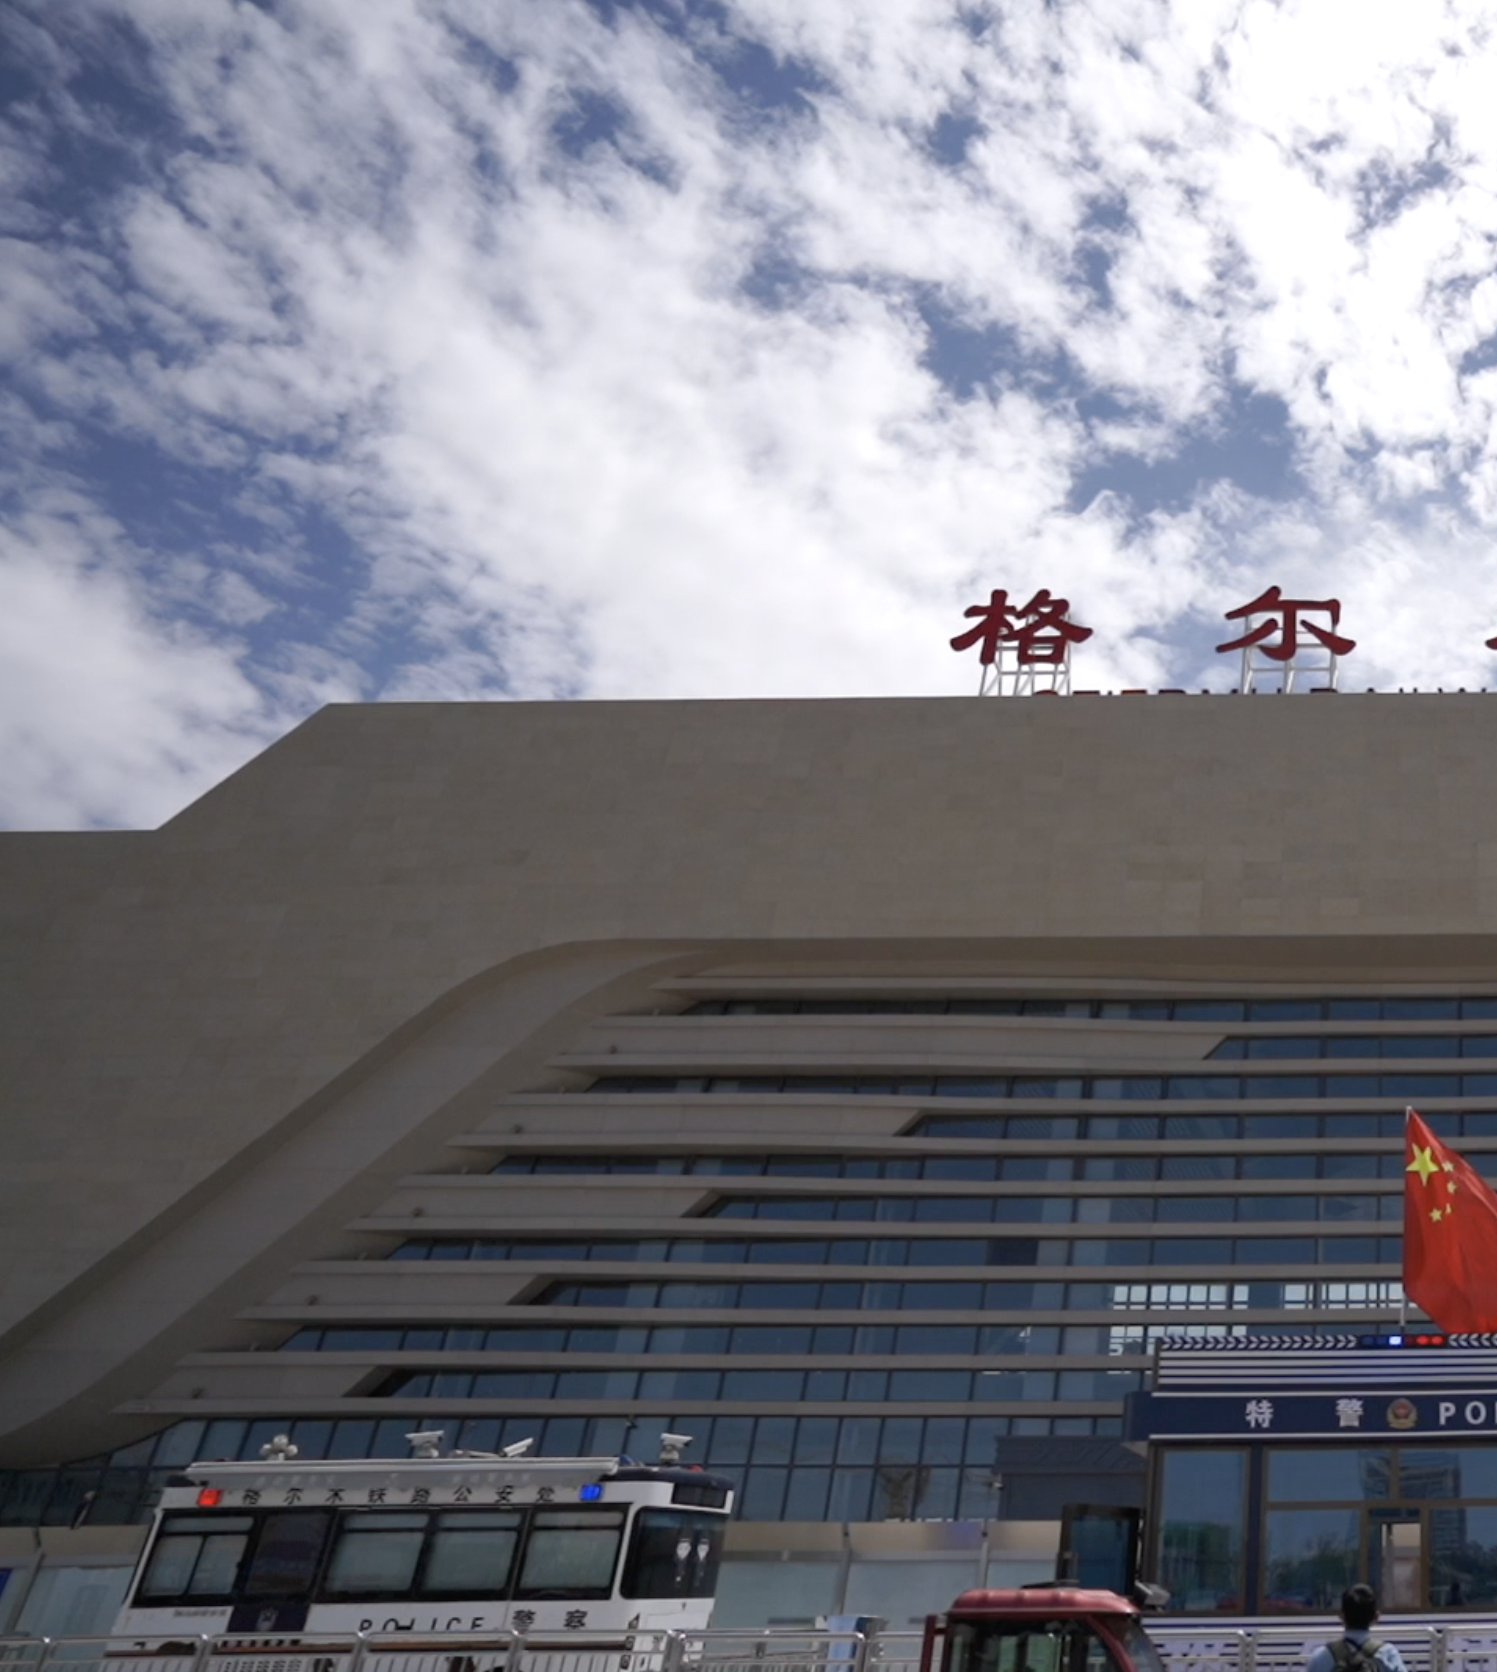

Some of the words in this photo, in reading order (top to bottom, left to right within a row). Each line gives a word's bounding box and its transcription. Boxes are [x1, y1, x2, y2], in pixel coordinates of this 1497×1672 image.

[1245, 1398, 1364, 1429] 特警
[242, 1483, 556, 1505] 格尔木铁路公安处
[512, 1608, 589, 1630] 警察
